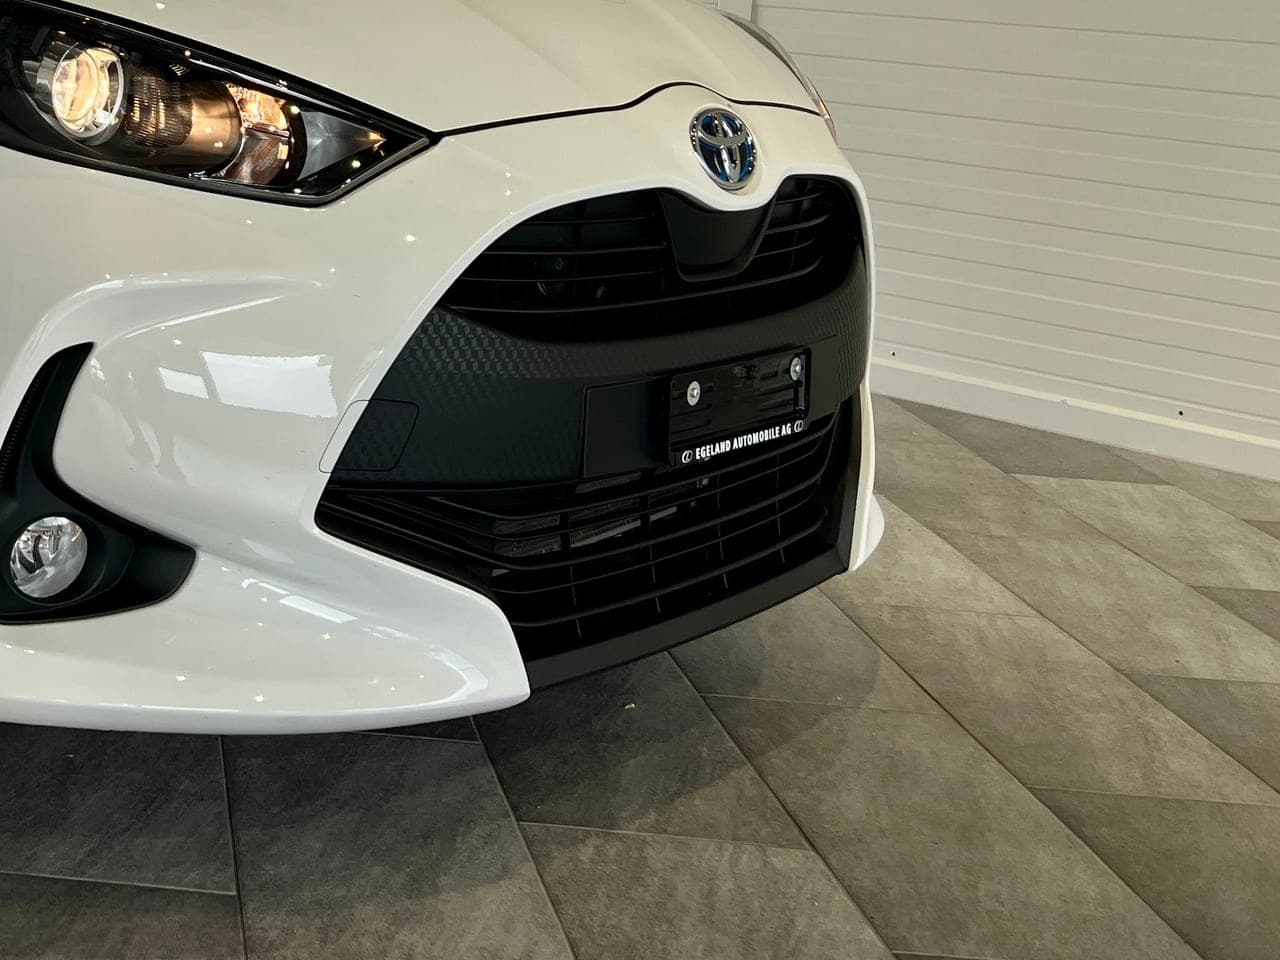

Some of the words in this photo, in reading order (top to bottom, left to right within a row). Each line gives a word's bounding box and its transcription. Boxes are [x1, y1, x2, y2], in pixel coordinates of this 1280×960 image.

[695, 439, 731, 460] EGELAND
[732, 426, 780, 450] AUTOMOBILE
[781, 423, 792, 437] AG
